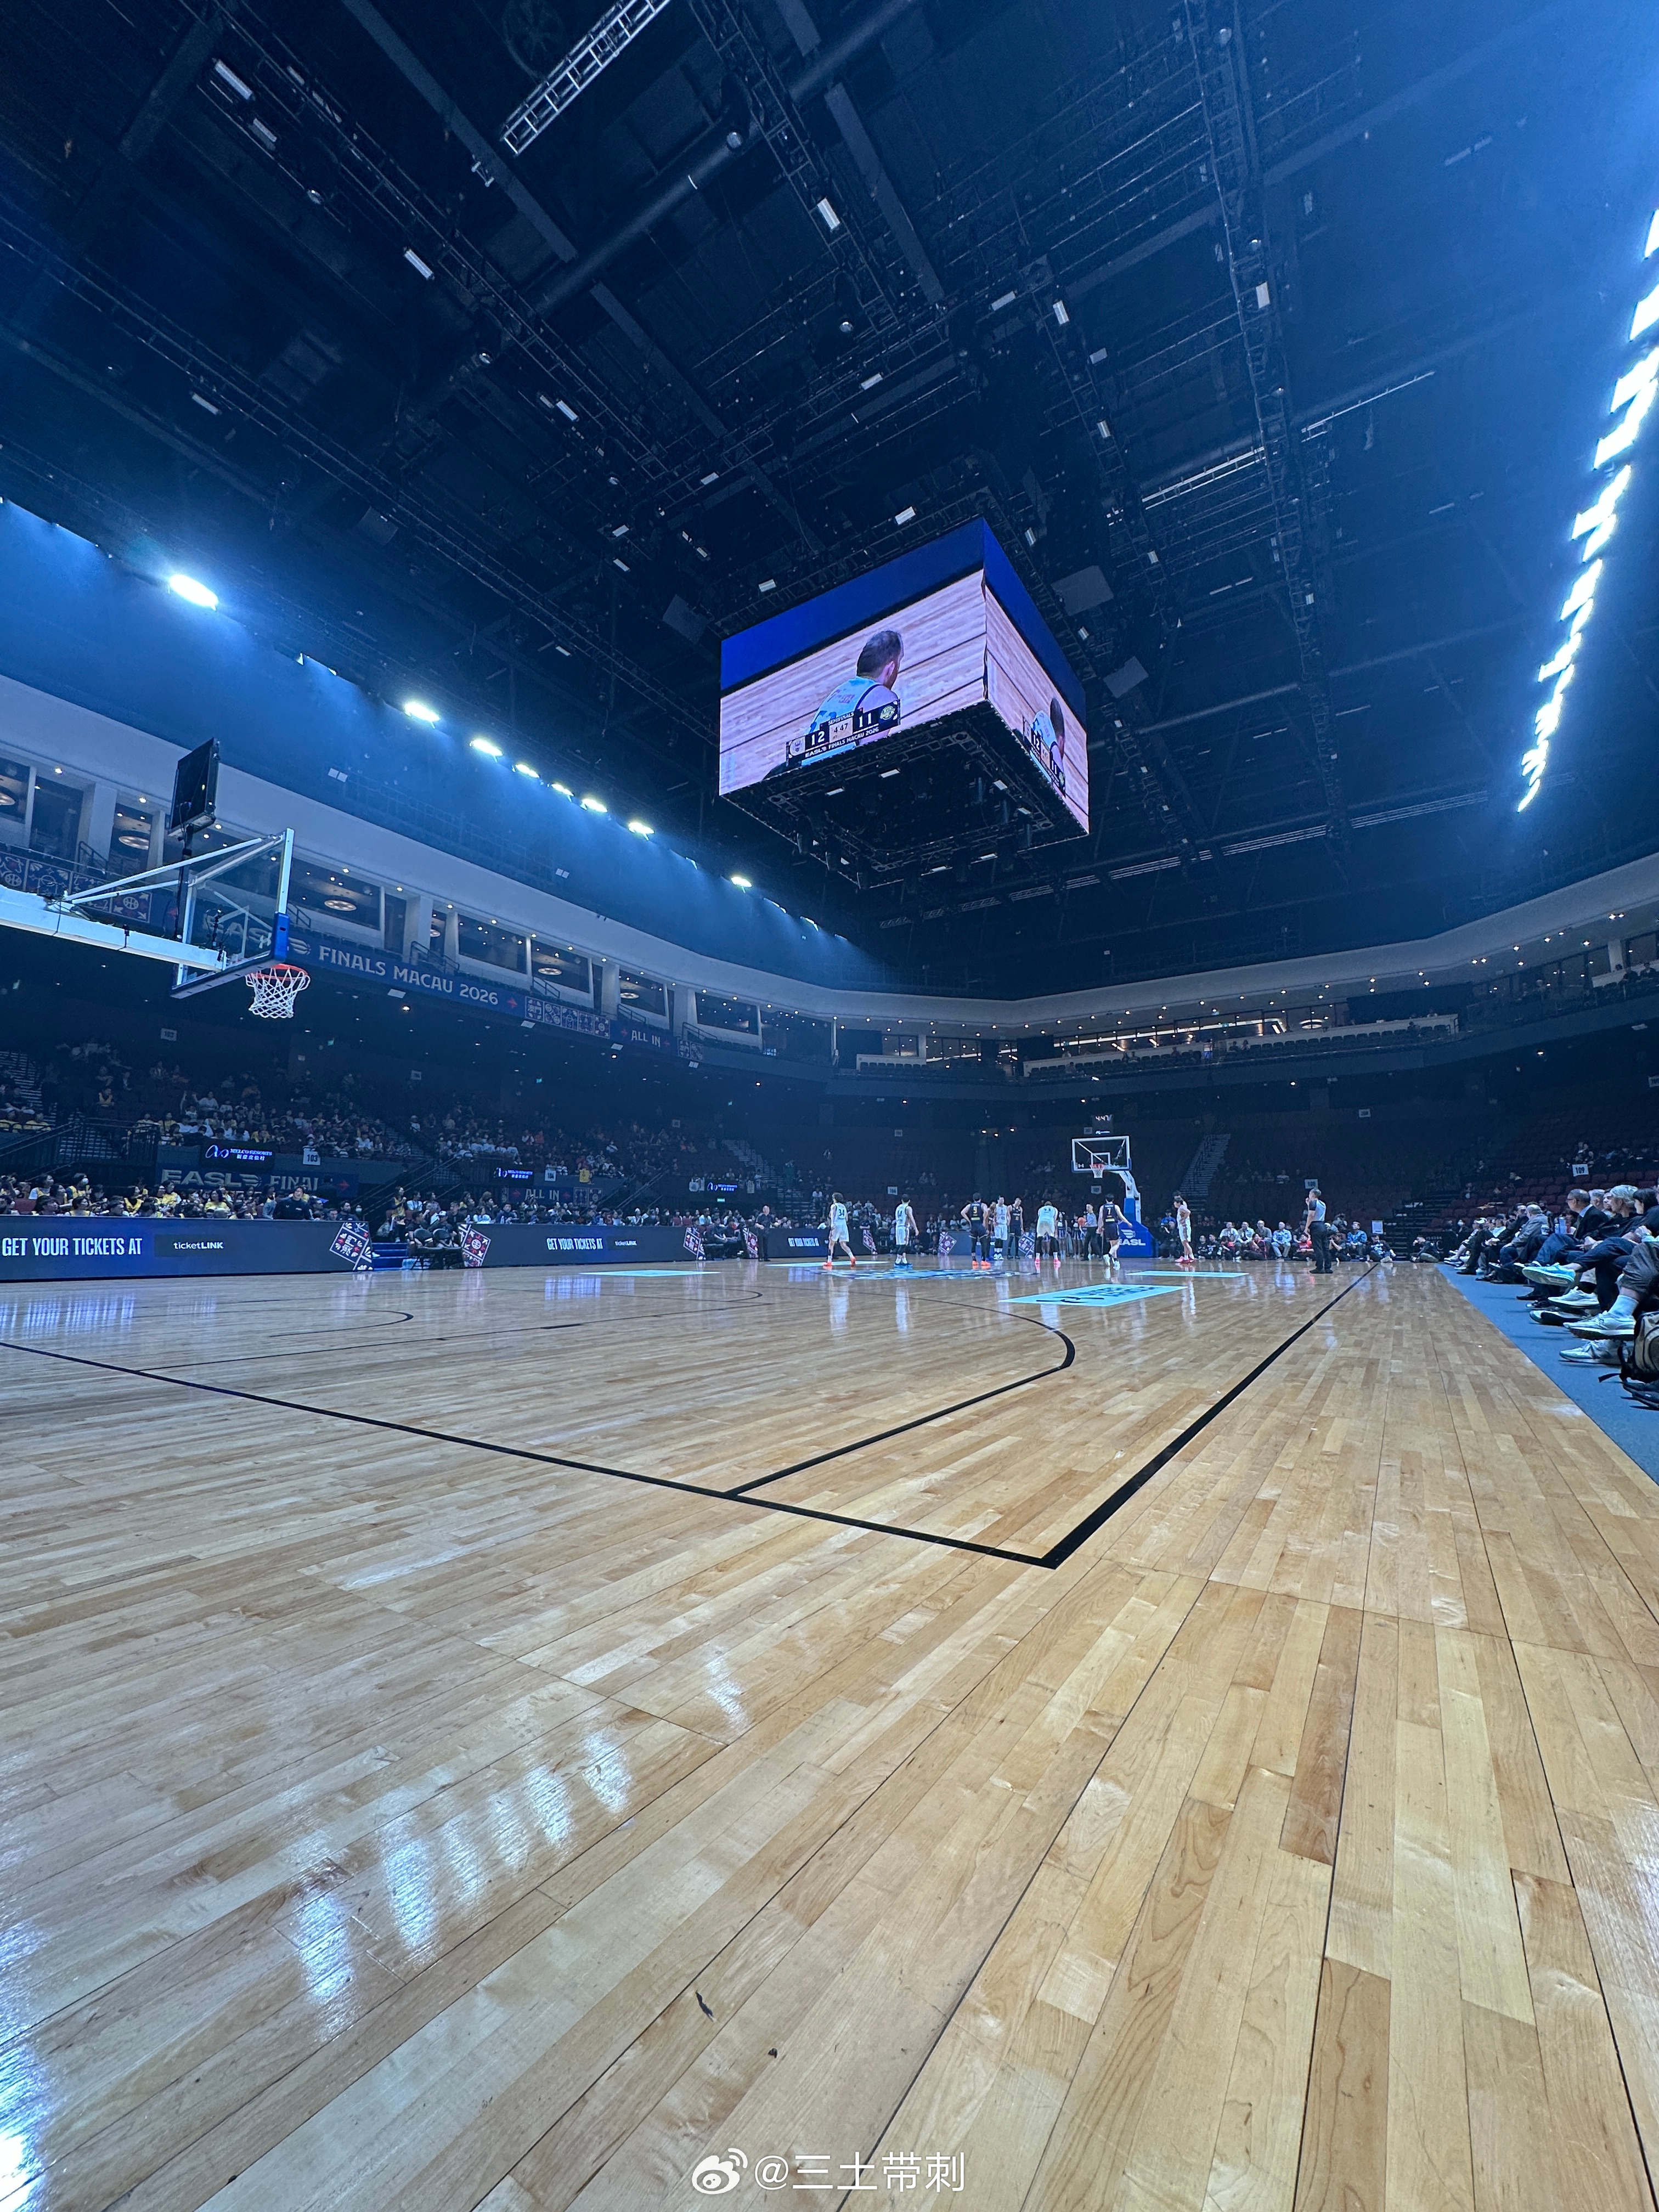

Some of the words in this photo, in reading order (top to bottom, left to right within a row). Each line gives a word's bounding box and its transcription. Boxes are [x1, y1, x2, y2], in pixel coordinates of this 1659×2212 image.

[859, 712, 872, 728] 11
[811, 731, 825, 746] 12
[847, 731, 865, 743] MACAU
[318, 945, 386, 977] FINALS
[393, 964, 453, 994] MACAU
[459, 983, 499, 1006] 2026
[631, 1029, 648, 1043] ALL
[651, 1035, 661, 1048] IN
[307, 1154, 318, 1162] 103
[161, 1169, 242, 1188] EASL
[524, 1188, 545, 1201] ALL
[549, 1190, 560, 1202] IN
[838, 1209, 845, 1217] 34
[2, 1237, 29, 1256] GET
[33, 1237, 69, 1256] YOUR
[72, 1237, 125, 1256] TICKETS
[128, 1237, 143, 1255] AT
[173, 1242, 224, 1250] ticketLINK
[546, 1238, 558, 1250] GET
[558, 1238, 574, 1250] YOUR
[574, 1238, 596, 1250] TICKETS
[596, 1238, 603, 1250] AT
